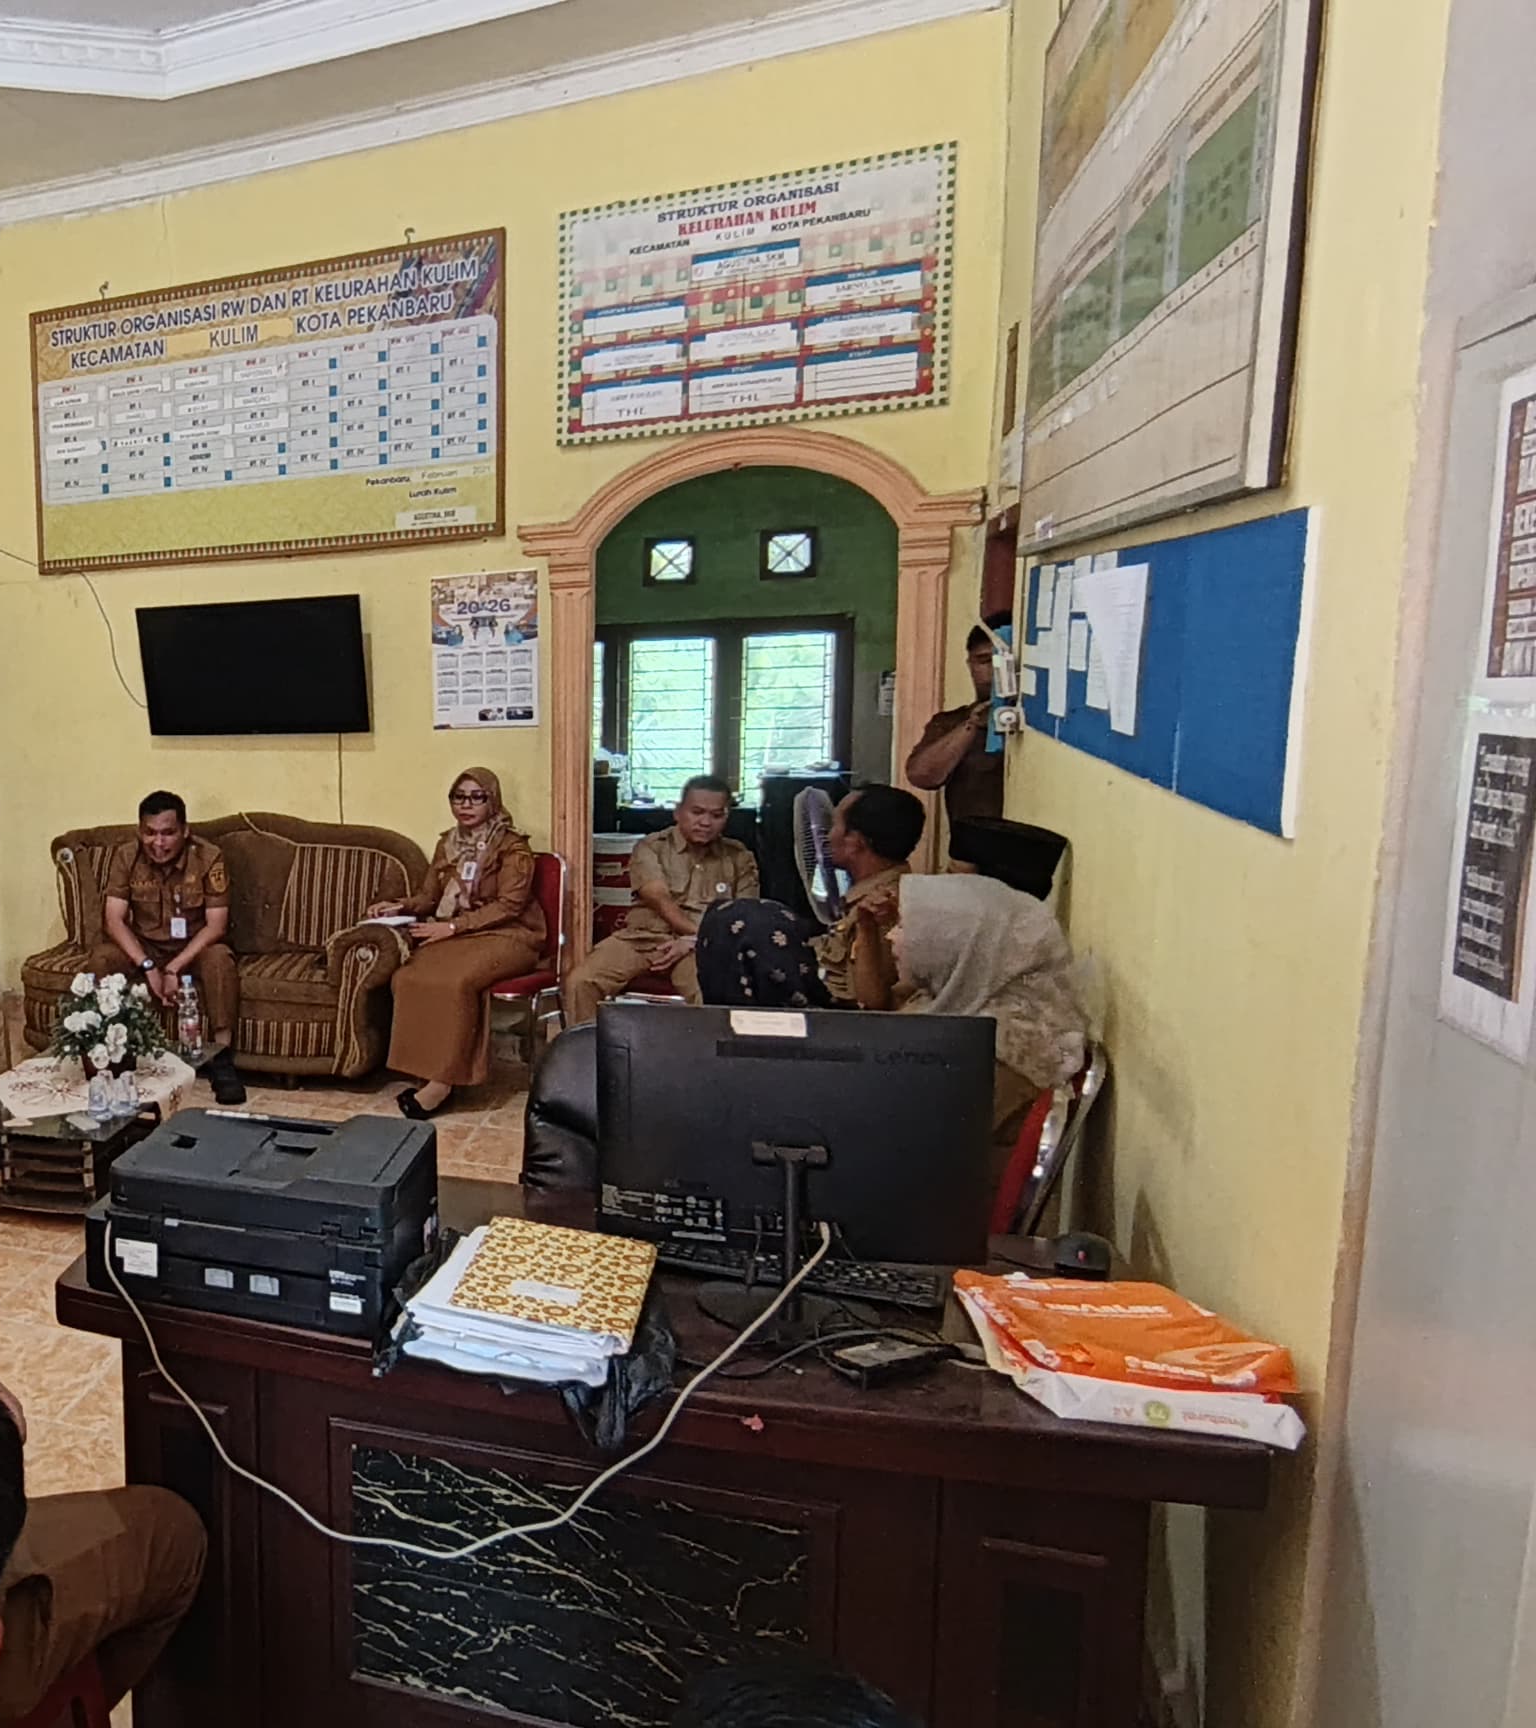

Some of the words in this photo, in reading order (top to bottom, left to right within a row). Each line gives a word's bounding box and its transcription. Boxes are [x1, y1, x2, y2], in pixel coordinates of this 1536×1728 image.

[657, 200, 739, 223] STRUKTUR
[743, 182, 840, 208] ORGANISASI
[677, 210, 765, 236] KELURAHAN
[770, 201, 817, 220] KULIM
[629, 239, 690, 255] KECAMATAN
[716, 227, 755, 241] KULIM
[771, 220, 800, 233] KOTA
[802, 209, 871, 228] PEKANBARU
[51, 321, 117, 348] STRUKTUR
[121, 304, 216, 335] ORGANISASI
[221, 299, 245, 319] RW
[250, 292, 286, 314] DAN
[292, 288, 309, 308] RT
[315, 271, 416, 304] KELURAHAN
[424, 257, 477, 287] KULIM
[71, 340, 164, 369] KECAMATAN
[209, 324, 259, 348] KULIM
[296, 312, 342, 334] KOTA
[348, 291, 453, 326] PEKANBARU
[457, 598, 511, 615] 2026
